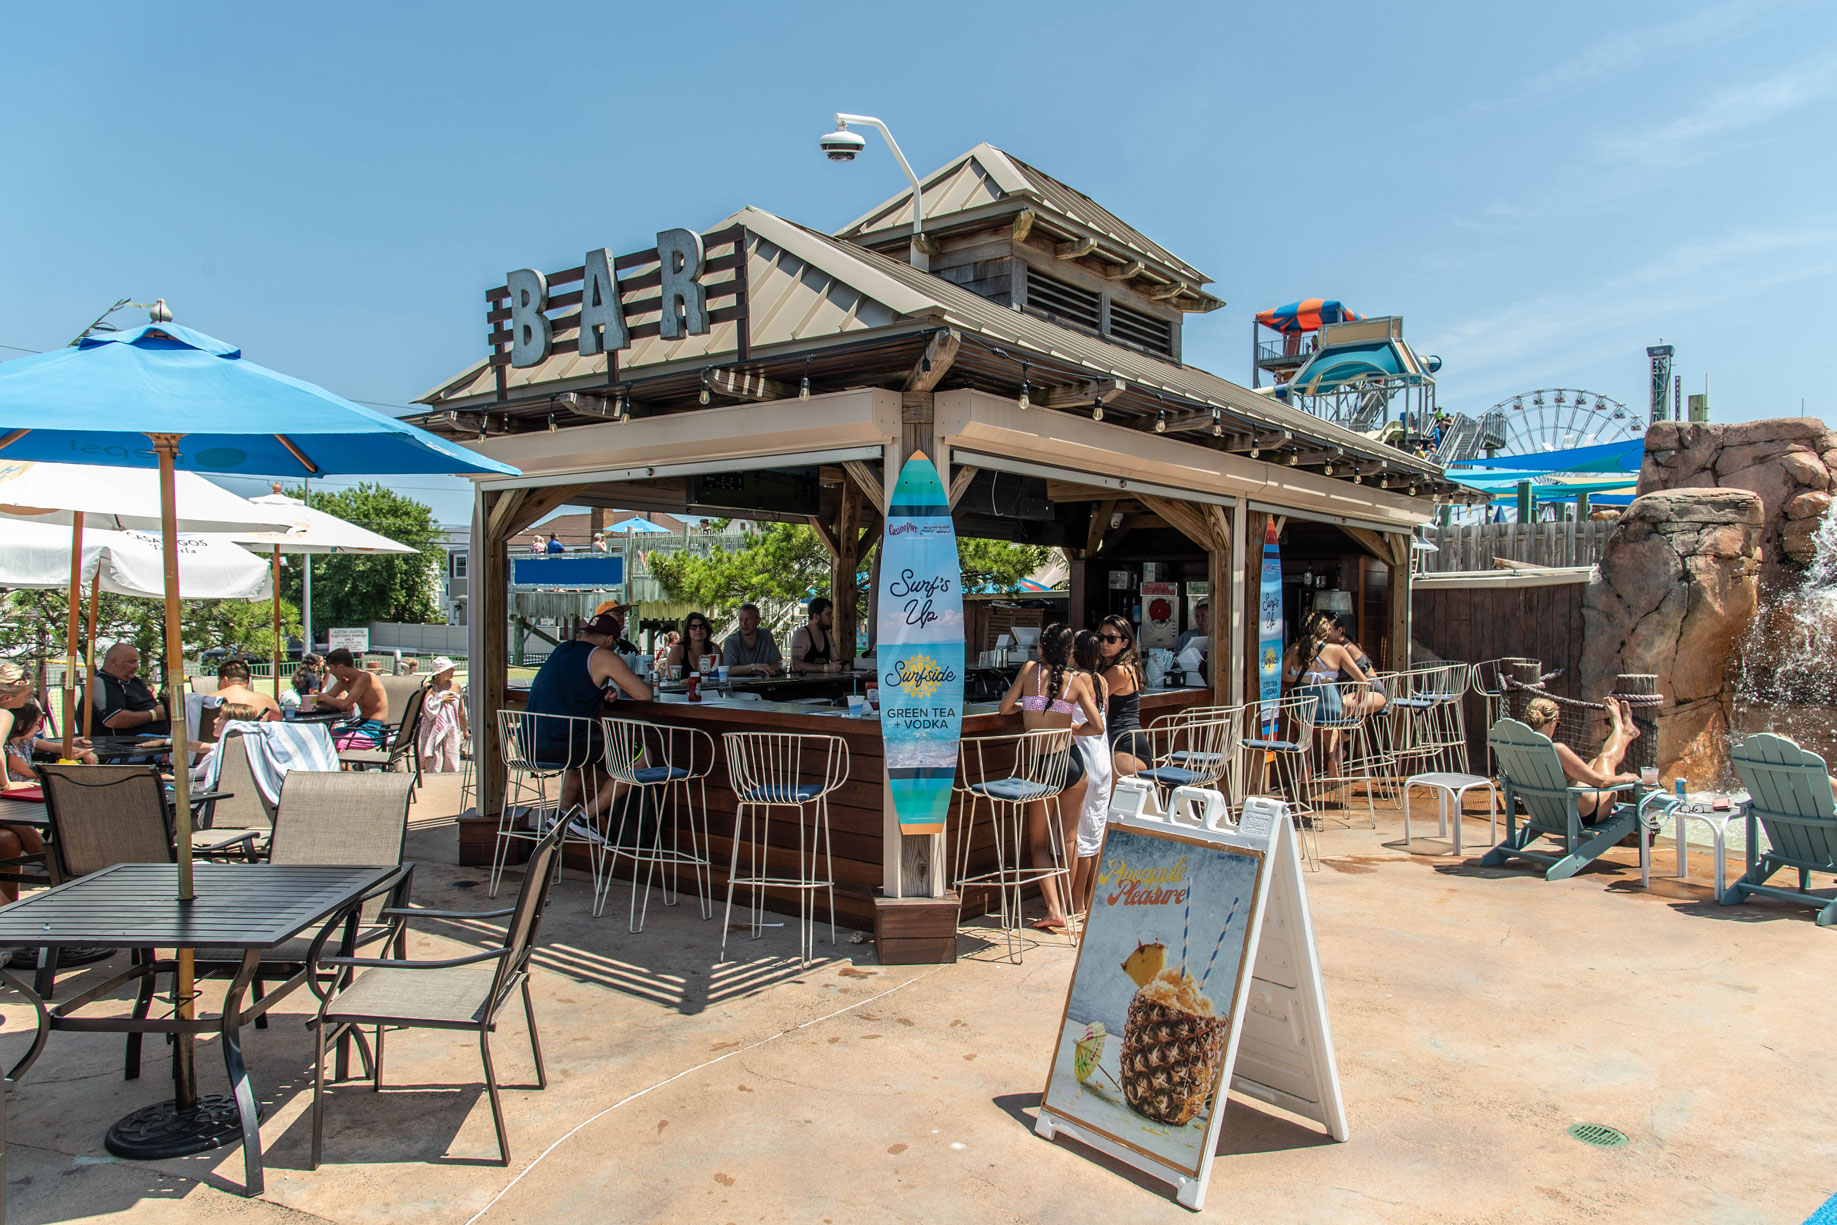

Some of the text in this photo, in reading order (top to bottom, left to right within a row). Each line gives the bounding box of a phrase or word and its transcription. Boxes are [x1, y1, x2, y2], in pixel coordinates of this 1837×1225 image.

[506, 227, 710, 368] BAR
[126, 531, 208, 547] CASAGOS
[890, 568, 951, 598] Surf's
[904, 599, 939, 629] Up
[885, 660, 956, 687] Surfside
[887, 708, 955, 718] GREEN TEA
[894, 720, 949, 729] + VODKA
[1099, 855, 1187, 895] Pineapple
[1107, 879, 1187, 906] Pleasure
